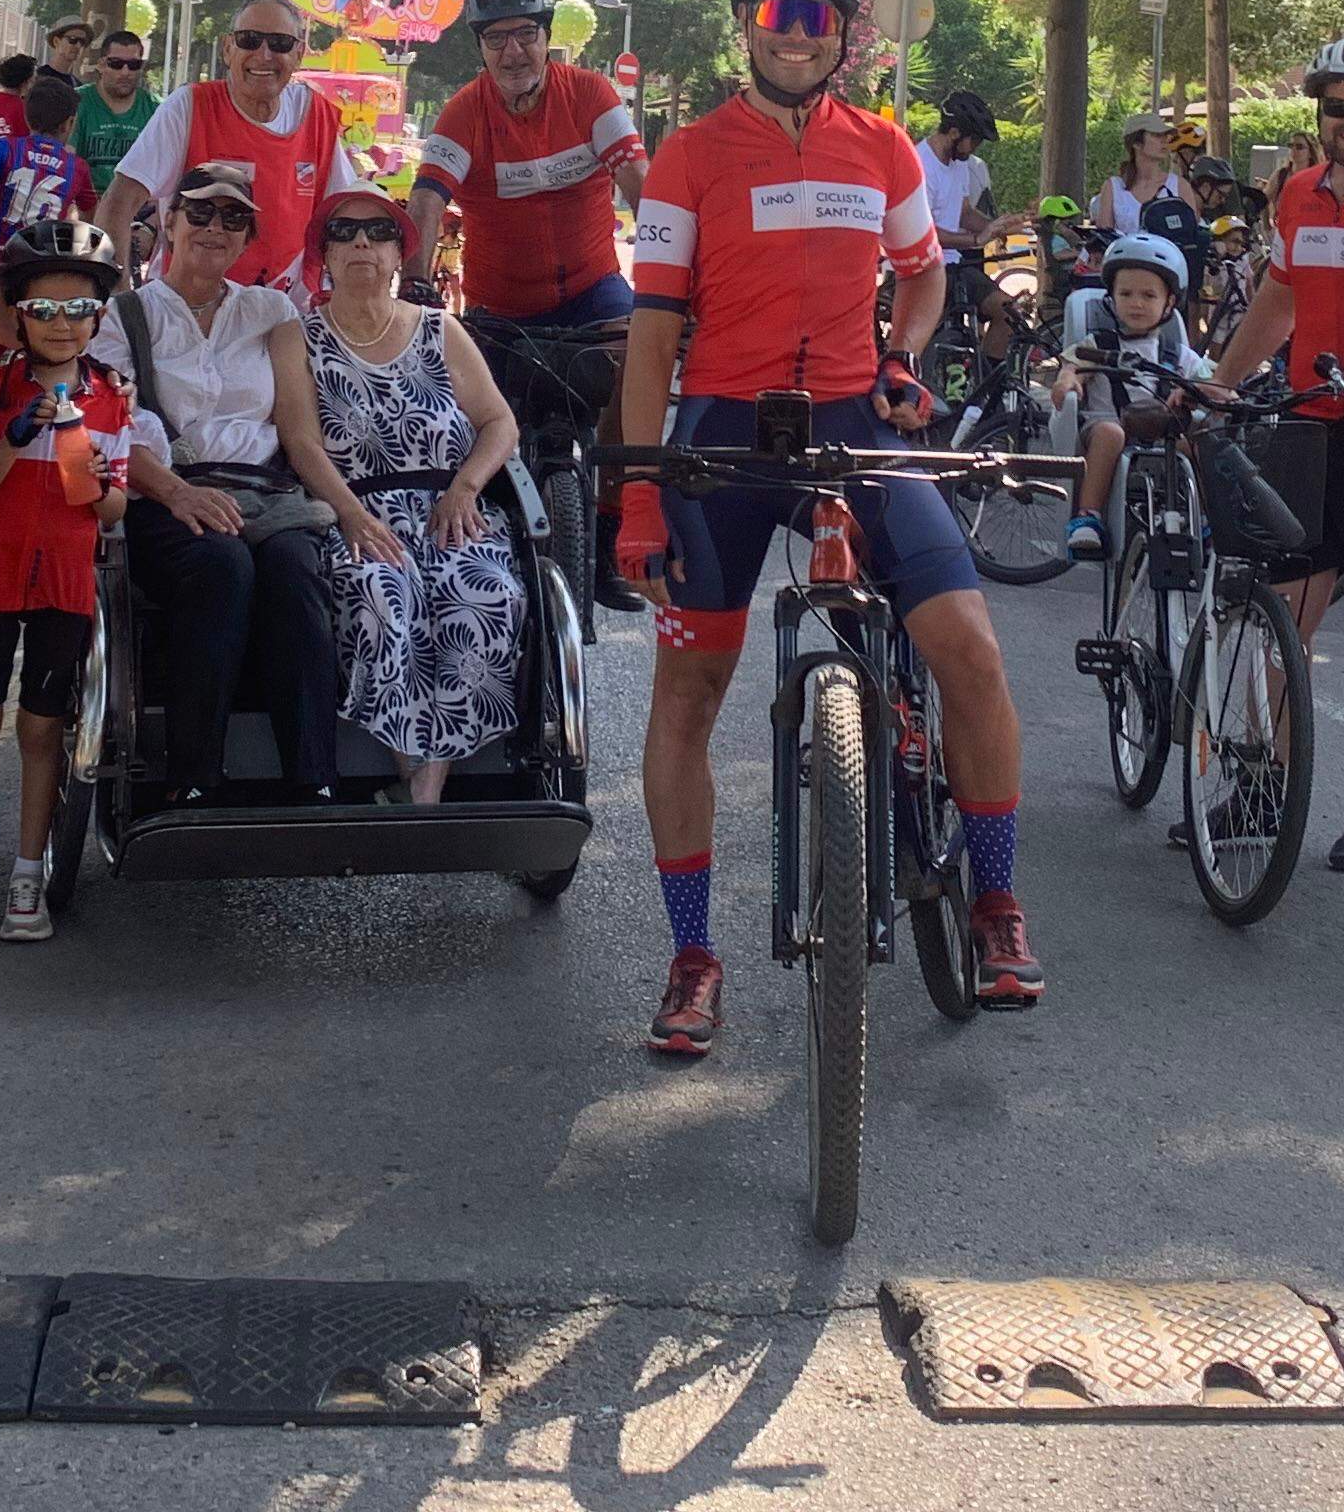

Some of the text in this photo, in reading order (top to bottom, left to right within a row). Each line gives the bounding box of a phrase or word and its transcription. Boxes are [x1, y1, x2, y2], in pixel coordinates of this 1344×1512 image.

[27, 150, 64, 169] PEDRI
[5, 166, 68, 228] 16
[760, 191, 794, 206] UNIÓ
[816, 191, 866, 206] CICLISTA
[816, 206, 849, 218] SANT
